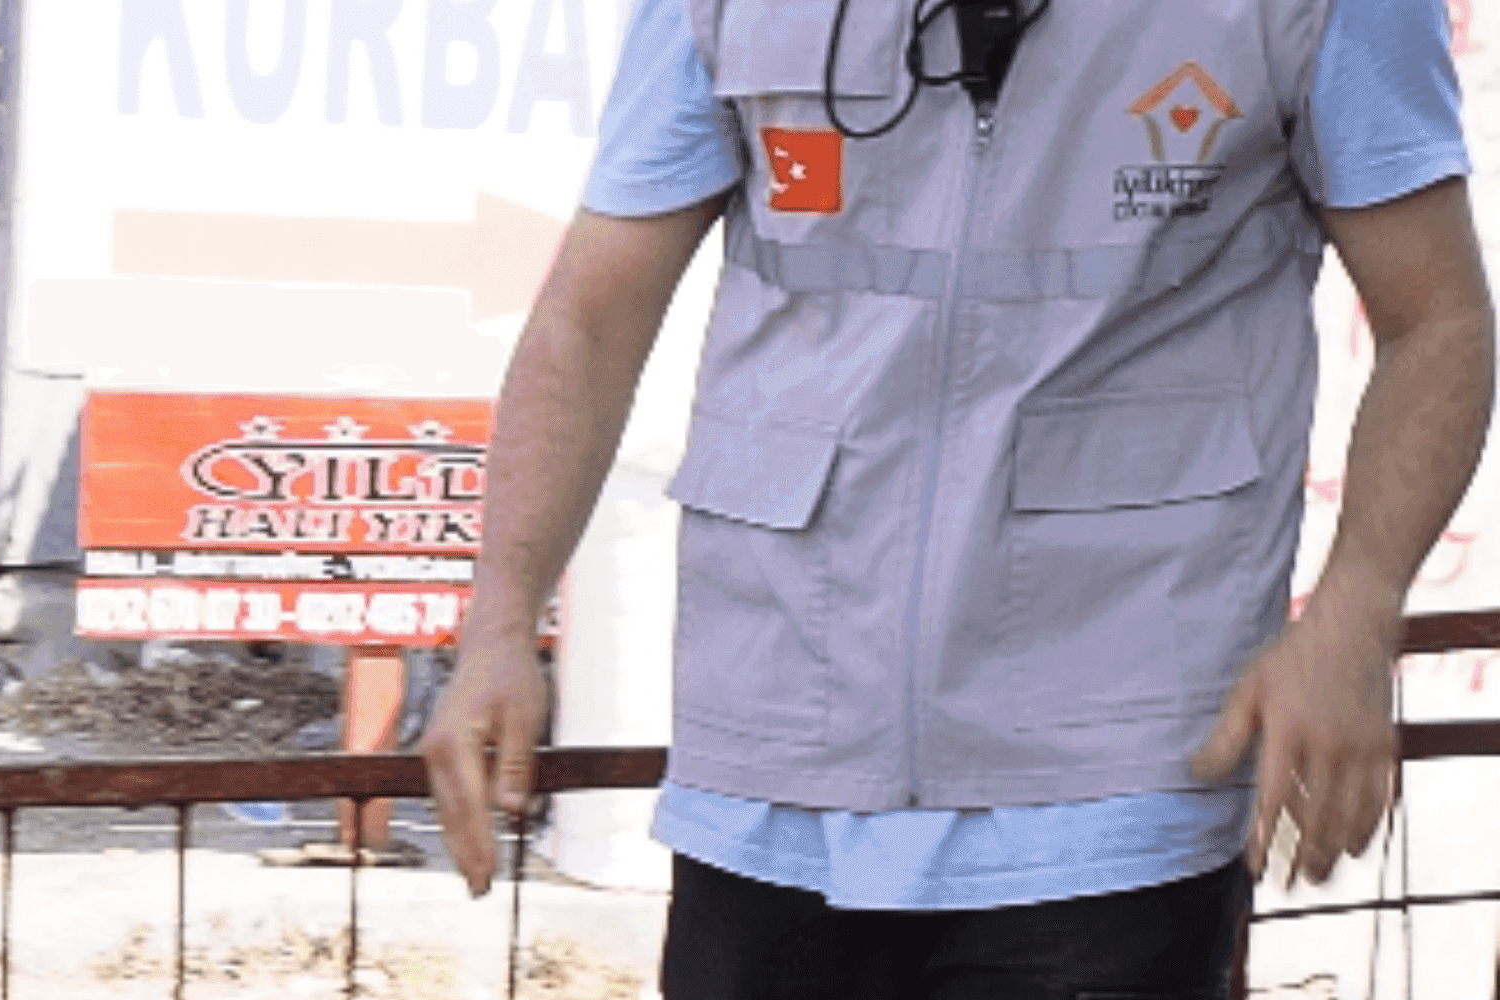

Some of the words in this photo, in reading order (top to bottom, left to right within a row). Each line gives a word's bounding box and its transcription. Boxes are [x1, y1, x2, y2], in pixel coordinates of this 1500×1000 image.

[114, 0, 604, 138] KURBA
[192, 444, 487, 501] YILD
[368, 511, 481, 542] YIK
